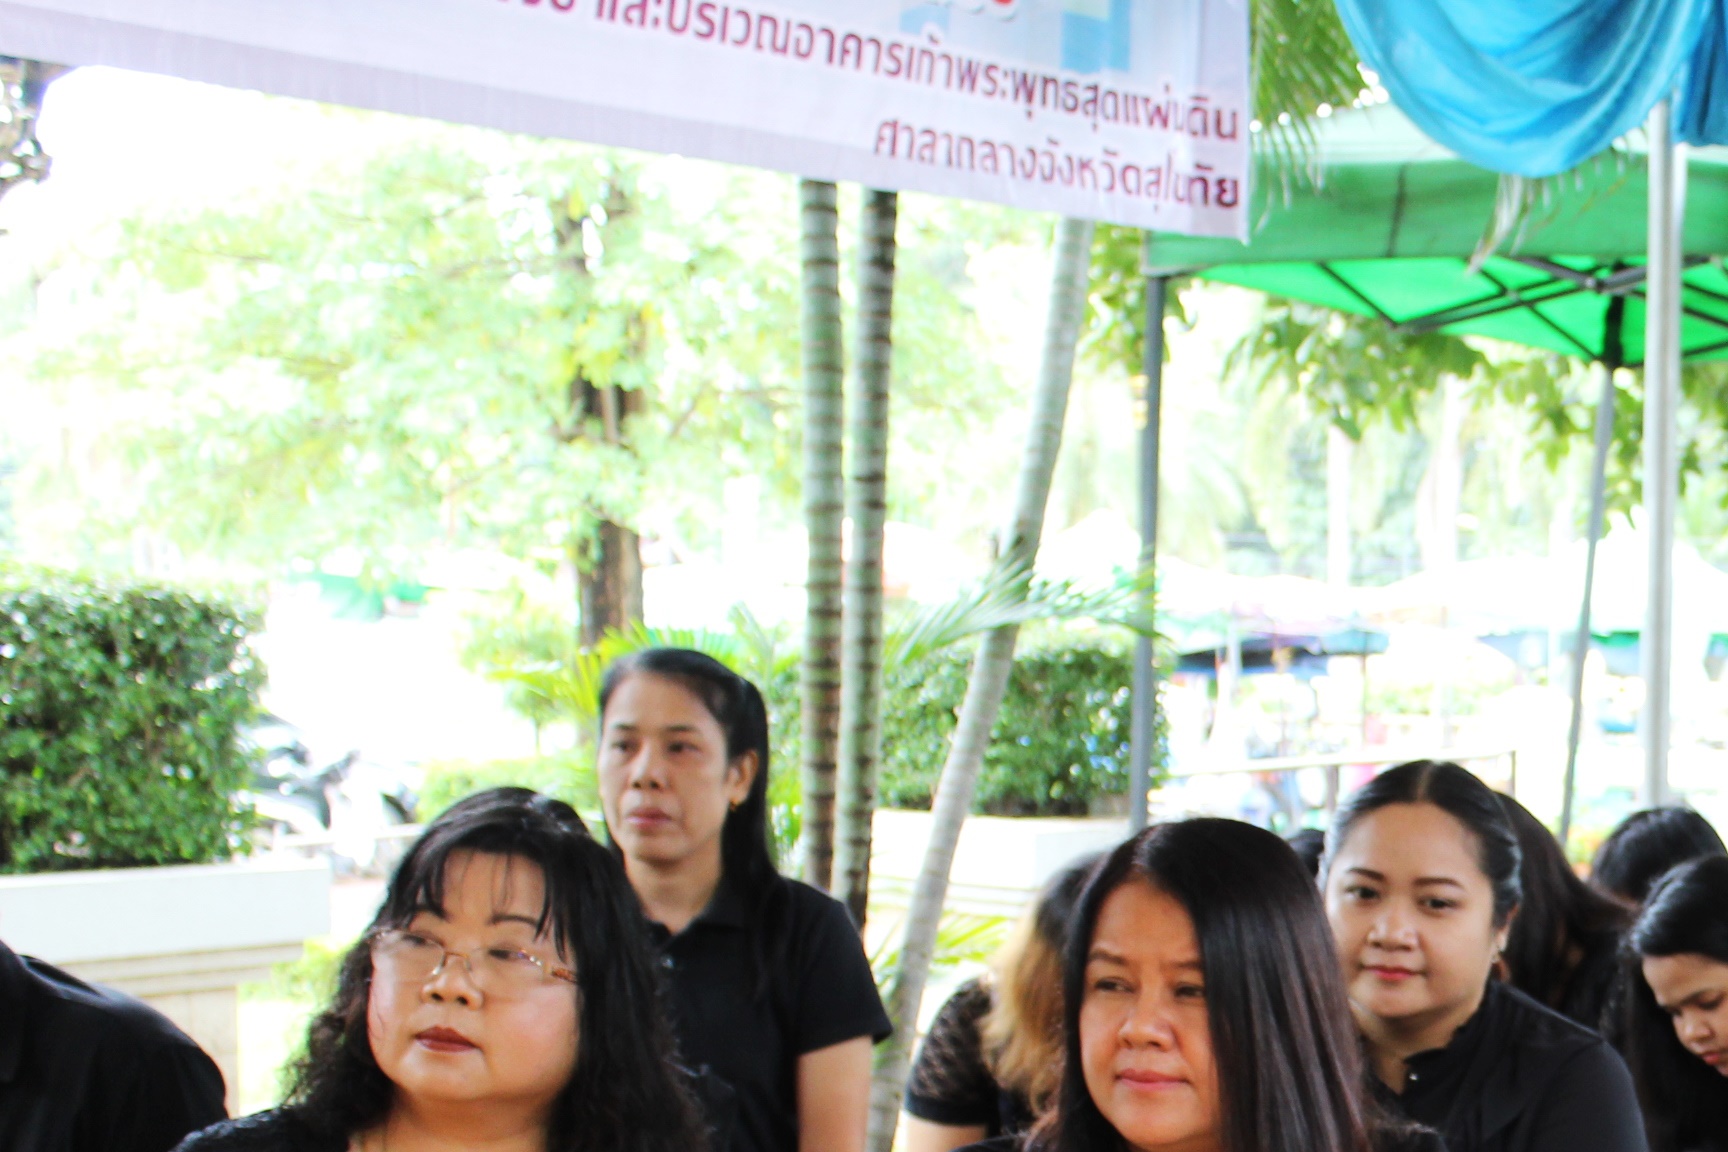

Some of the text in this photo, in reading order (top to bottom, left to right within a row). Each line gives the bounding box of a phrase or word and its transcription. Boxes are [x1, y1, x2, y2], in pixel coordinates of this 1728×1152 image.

[595, 0, 1239, 140] และบรเวณอาคารเก้าพระพุทธสุดแผ่นดิน
[874, 118, 1240, 212] ศาลากลางจังหวัดสุโขทัย
